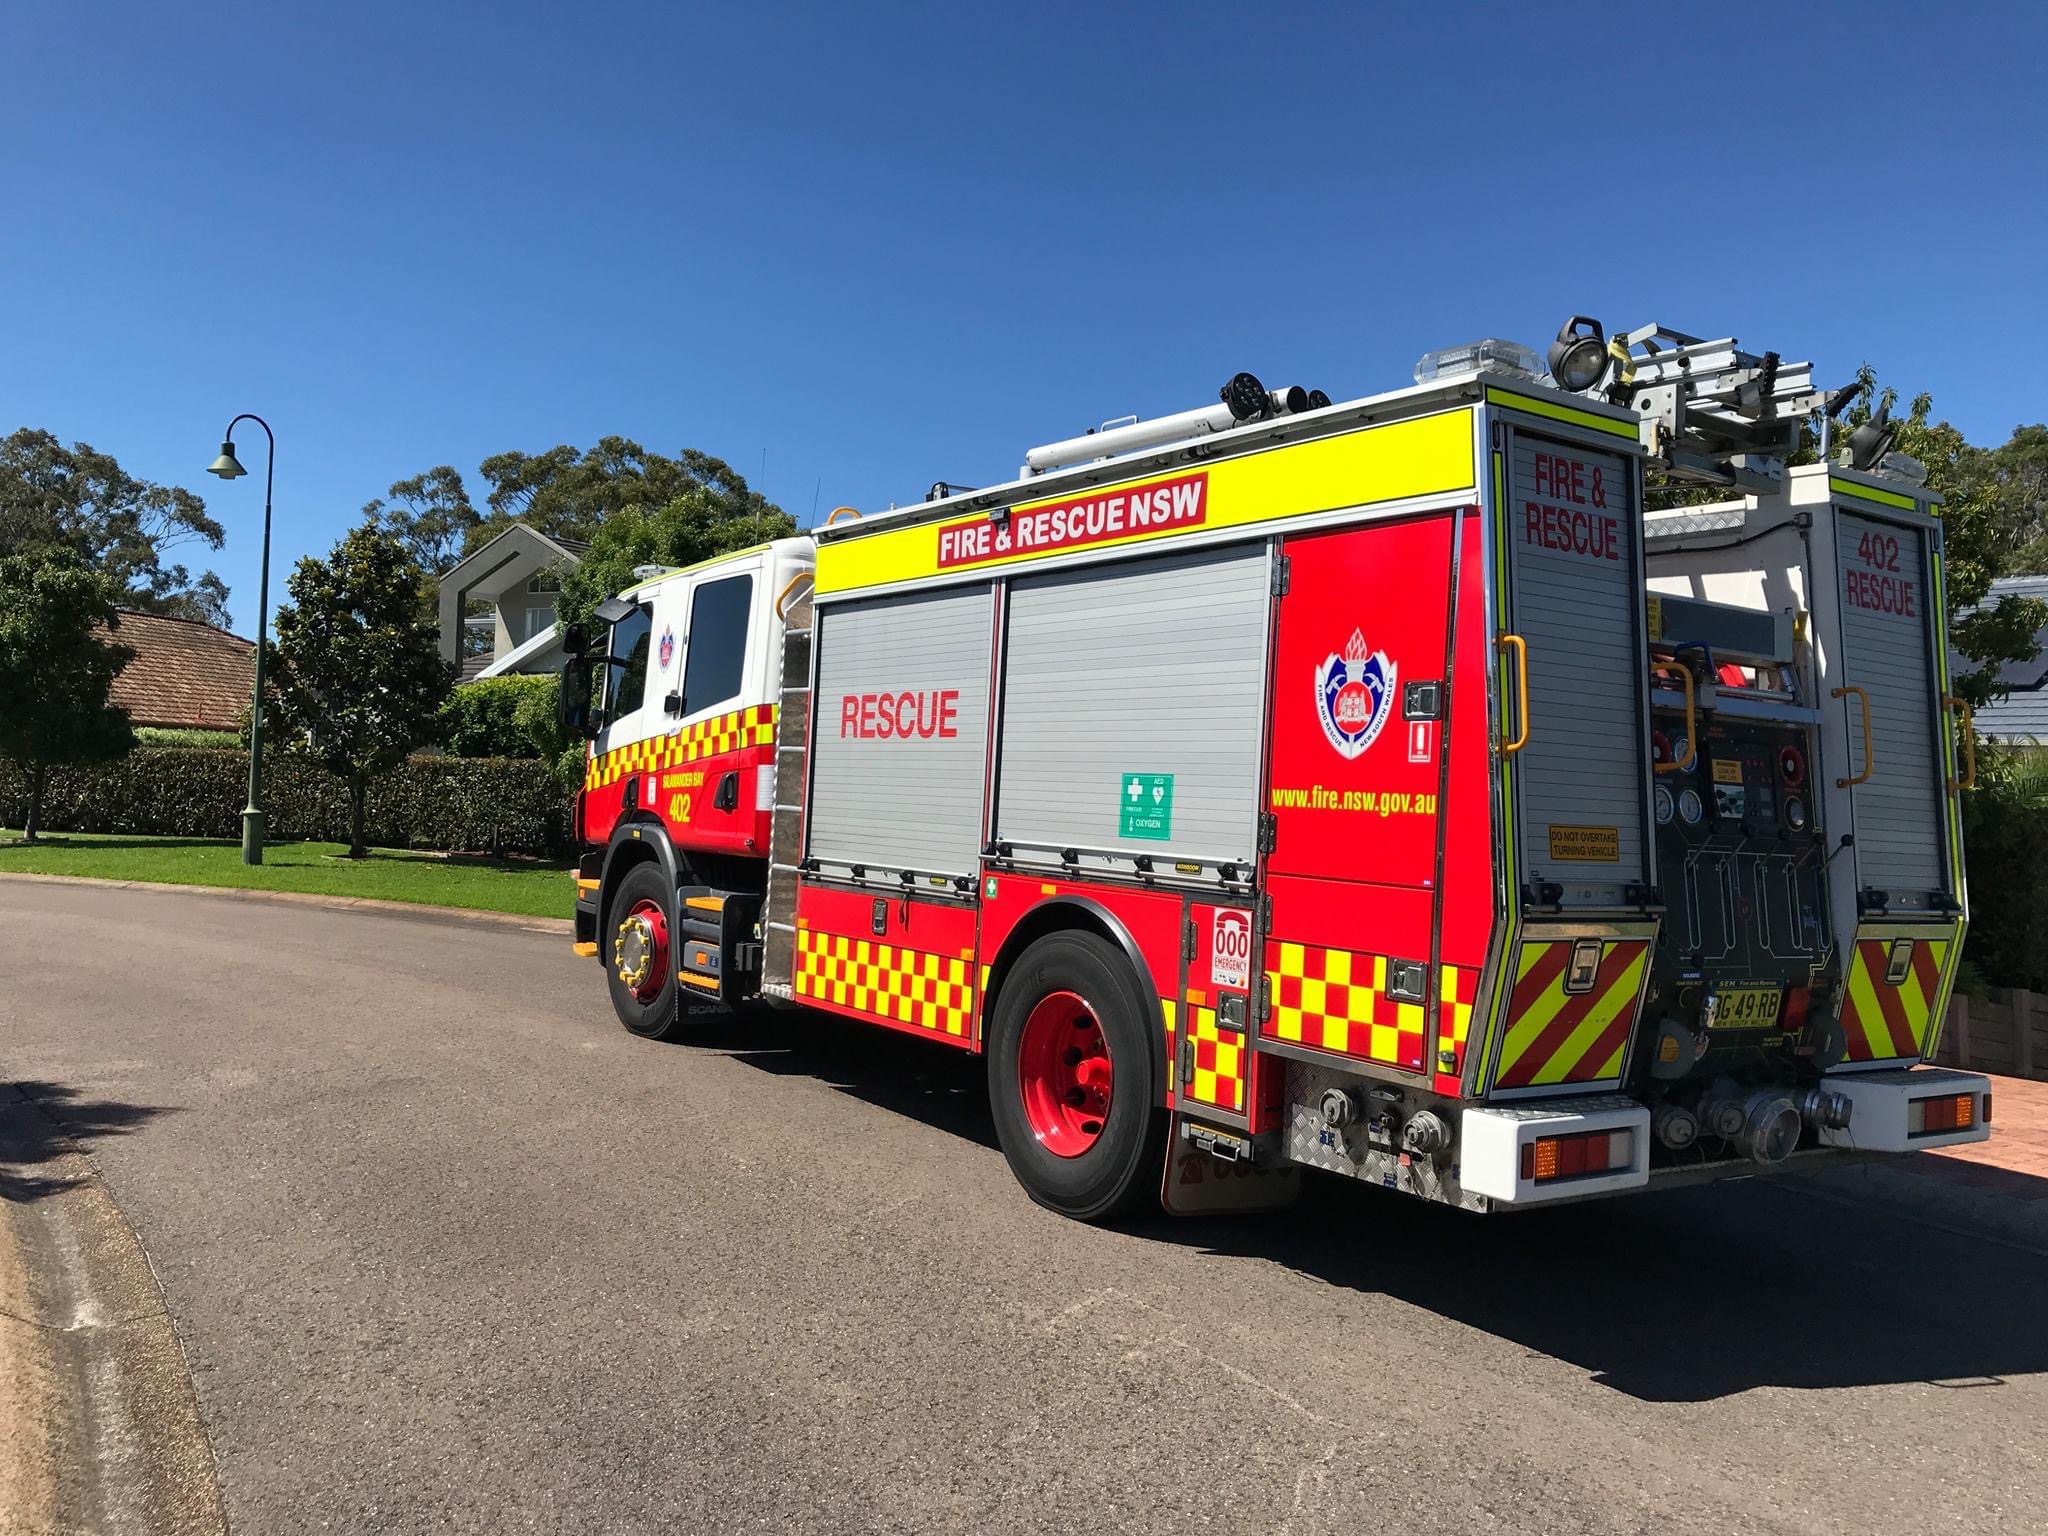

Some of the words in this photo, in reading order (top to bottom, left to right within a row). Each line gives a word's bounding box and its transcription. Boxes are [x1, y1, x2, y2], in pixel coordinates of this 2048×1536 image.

[1535, 453, 1586, 504] FIRE
[1591, 466, 1607, 509] &
[940, 524, 992, 561] FIRE
[994, 528, 1012, 552] &
[1017, 497, 1126, 548] RESCUE
[1129, 481, 1202, 528] NSW
[1525, 501, 1619, 560] RESCUE
[1857, 531, 1900, 573] 402
[1846, 568, 1915, 618] RESCUE
[840, 690, 959, 739] RESCUE
[1359, 733, 1373, 749] NEW
[1371, 708, 1387, 734] SOUTH
[1383, 677, 1394, 706] WALES
[1324, 722, 1343, 748] RESCUE
[669, 793, 691, 823] 402
[1272, 785, 1437, 817] www.fire.nsw.gov.au
[1135, 818, 1161, 829] OXYGEN
[1551, 832, 1563, 841] DO
[1564, 832, 1579, 842] NOT
[1580, 833, 1617, 843] OVERTAKE
[1553, 845, 1586, 856] TURNING
[1587, 846, 1616, 857] VEHICLE
[1216, 929, 1248, 958] 000
[1214, 956, 1248, 972] EMERGENCY
[687, 1004, 734, 1015] SCANIA
